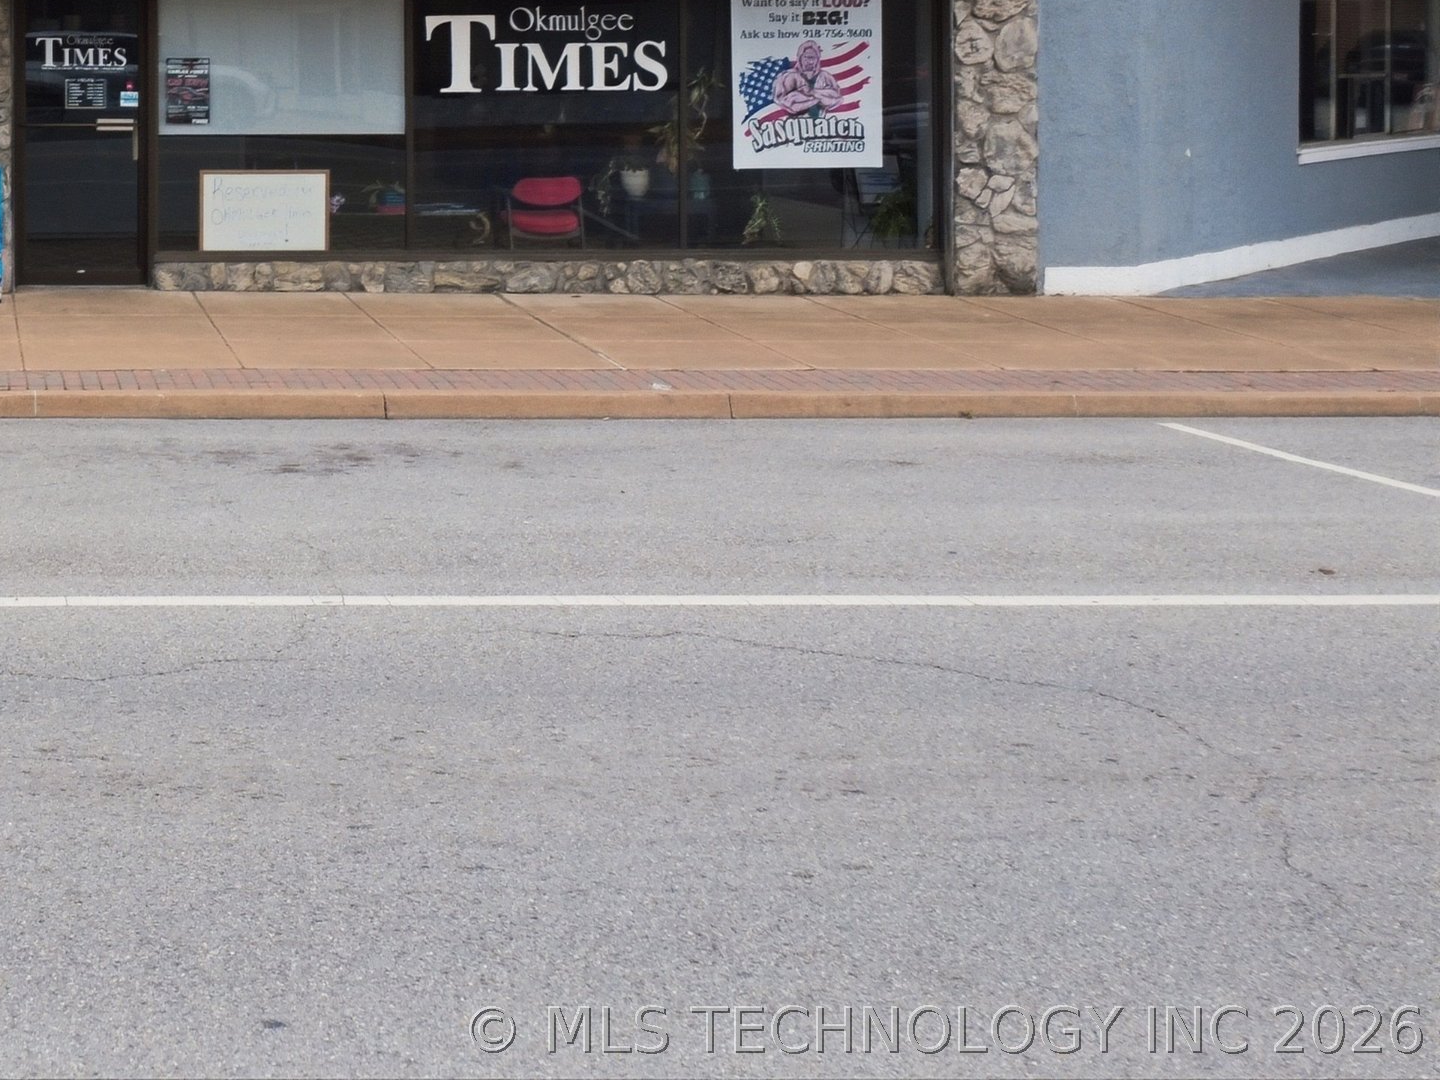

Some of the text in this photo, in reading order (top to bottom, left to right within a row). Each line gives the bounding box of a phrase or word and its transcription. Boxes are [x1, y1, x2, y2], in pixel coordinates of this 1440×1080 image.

[789, 0, 809, 9] say
[510, 6, 634, 41] Okmulgee
[768, 11, 849, 25] Say it BIG!
[740, 29, 873, 39] Ask us how 918-756-3600
[35, 37, 127, 68] TIMES
[425, 15, 668, 93] TIMES
[748, 116, 865, 153] Sasquatch
[803, 139, 865, 153] PRINTING
